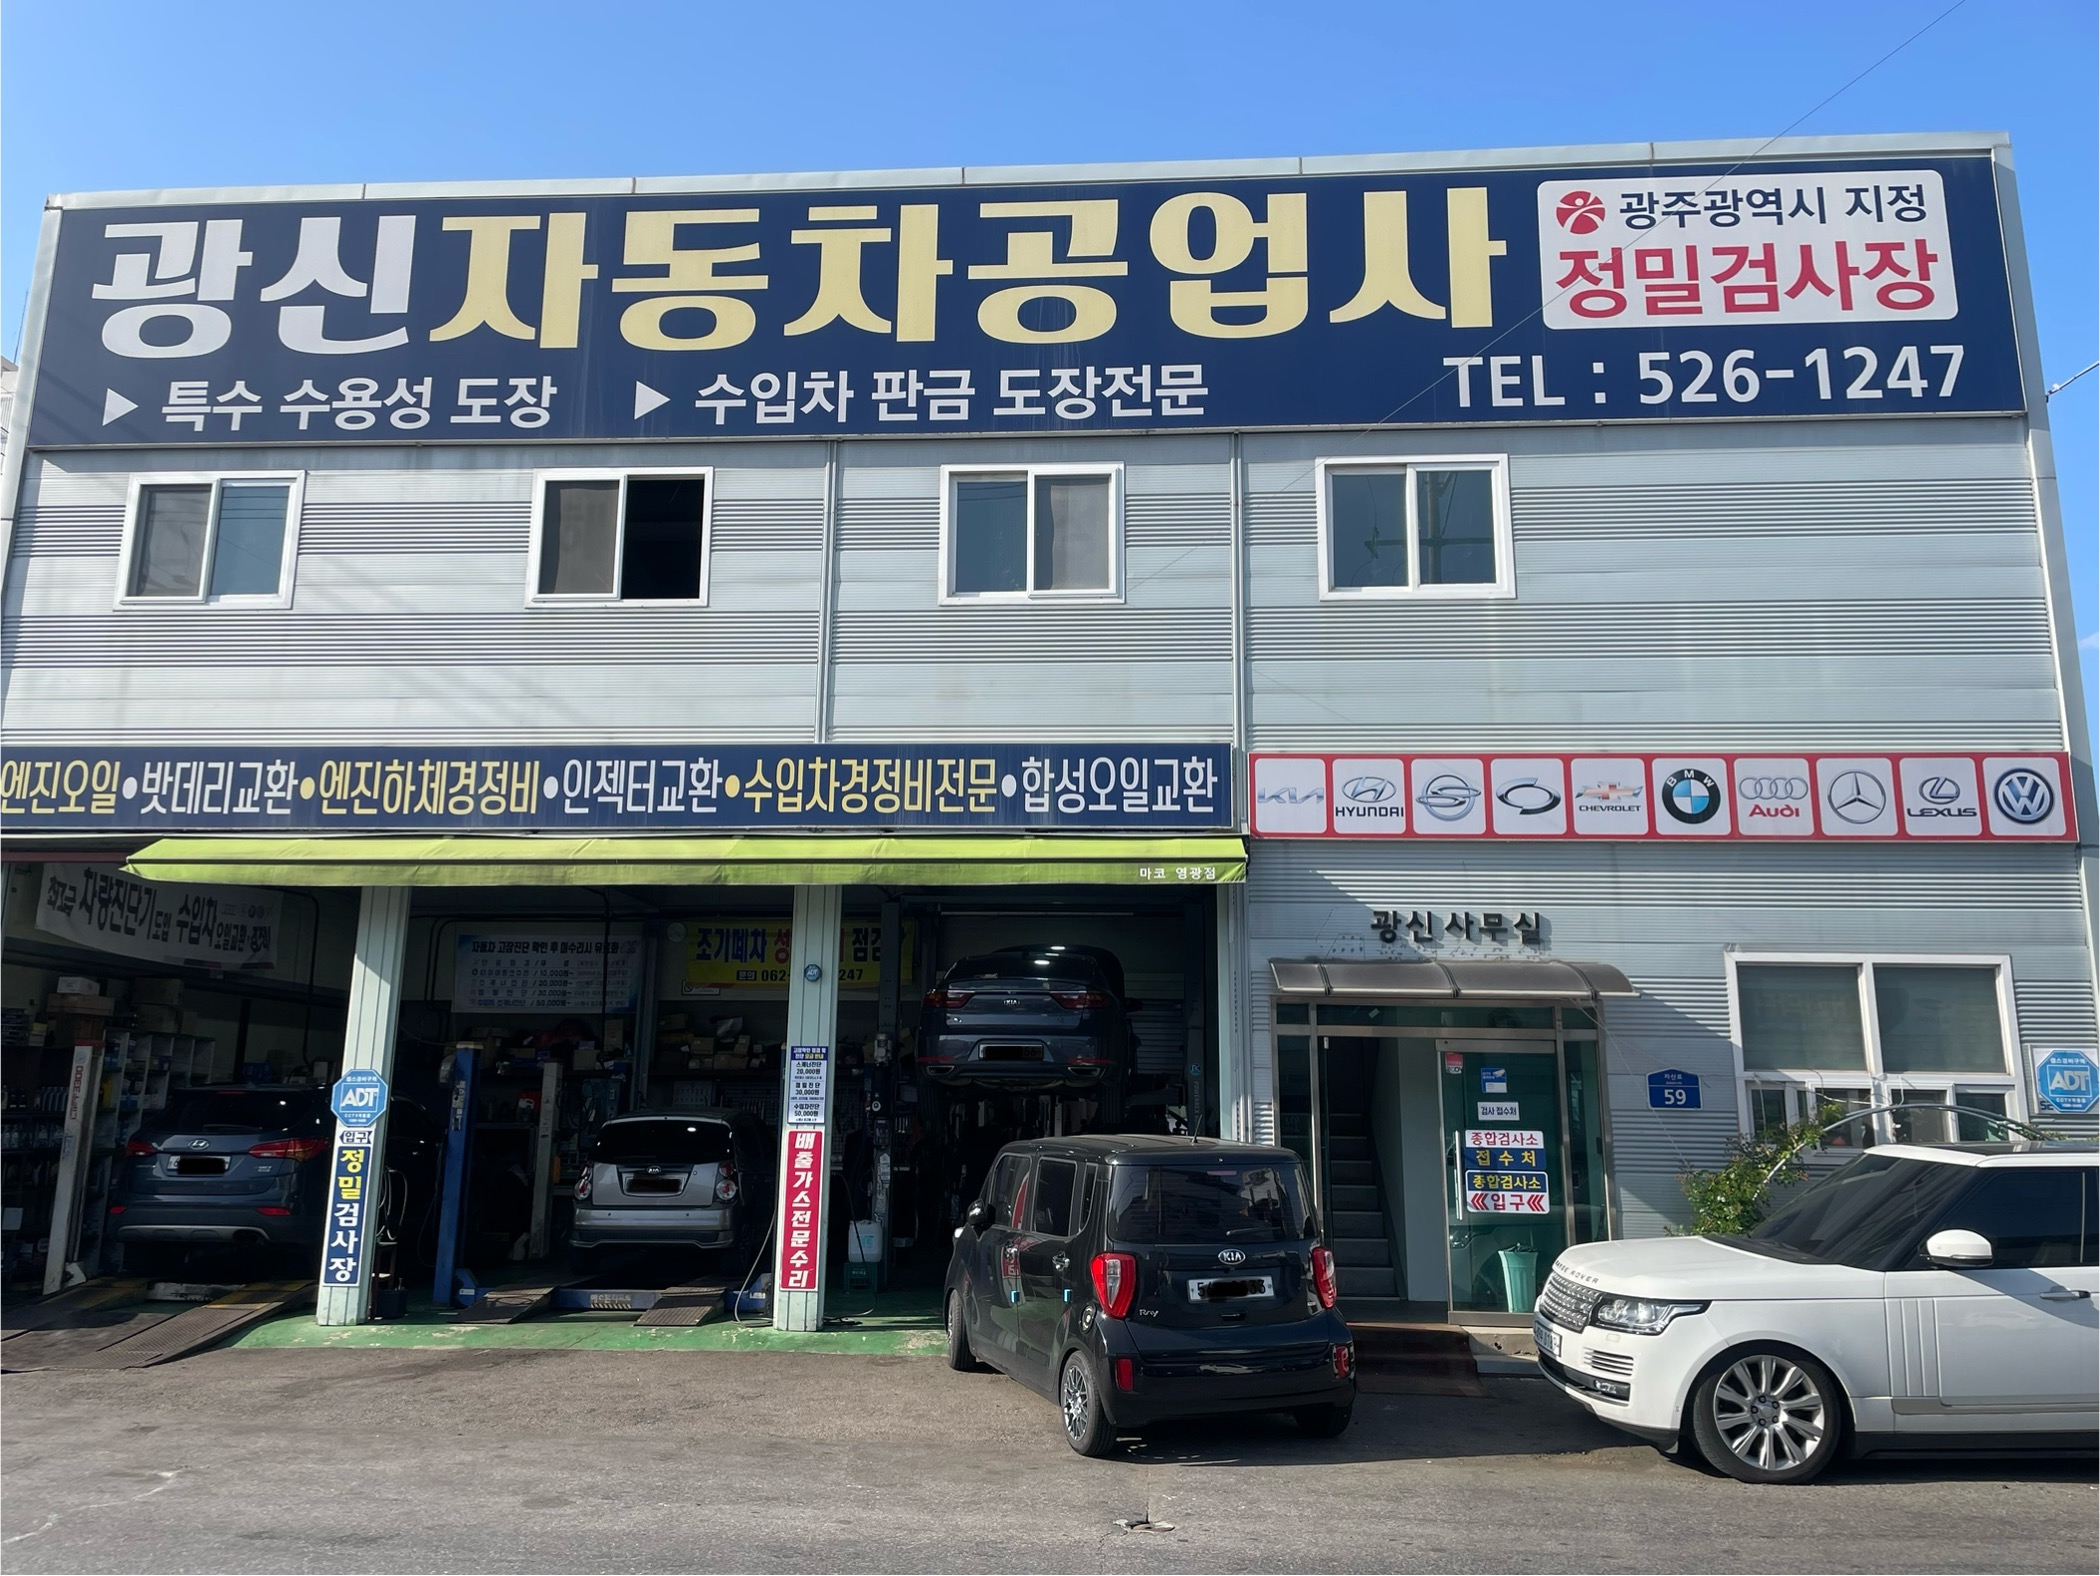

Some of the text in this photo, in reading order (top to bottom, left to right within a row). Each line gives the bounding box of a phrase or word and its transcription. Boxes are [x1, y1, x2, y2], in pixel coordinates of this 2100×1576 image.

[1619, 182, 1928, 229] 광주광역시 지정
[1556, 238, 1939, 318] 정밀검사장
[1444, 355, 1565, 407] TEL
[1638, 345, 1964, 405] 526-1247
[161, 375, 557, 432] 특수 수용성 도장
[695, 363, 1209, 425] 수입차 판금 도장전문
[1, 755, 1219, 815] 엔진오일 밧데리교환 엔진하체경정비 인젝터교환 수입차경정비전문 합성오일교환
[1335, 805, 1404, 819] HYUNDAI
[1578, 804, 1642, 813] CHEVROLET
[1748, 803, 1800, 818] Audi
[1906, 807, 1978, 818] LEXUS
[1139, 866, 1217, 880] 마코 영광점
[79, 866, 158, 940] 차량진단기
[176, 894, 218, 948] 수입차
[1370, 910, 1541, 945] 광신 사무실
[472, 941, 496, 953] 자동차
[696, 927, 767, 963] 조기폐차
[2050, 1070, 2089, 1091] ADT
[340, 1087, 379, 1107] ADT
[1664, 1089, 1687, 1105] 59
[1480, 1106, 1517, 1116] 검사 접수처
[344, 1131, 369, 1144] 입구
[1470, 1132, 1539, 1147] 종합검사소
[1472, 1174, 1541, 1190] 종합검사소
[788, 1132, 816, 1288] 배출가스전문수리
[1491, 1193, 1525, 1211] 입구
[328, 1149, 364, 1282] 정밀검사장
[1223, 1252, 1241, 1262] KIA
[1570, 1269, 1599, 1284] ROVER
[1138, 1308, 1159, 1318] Ray
